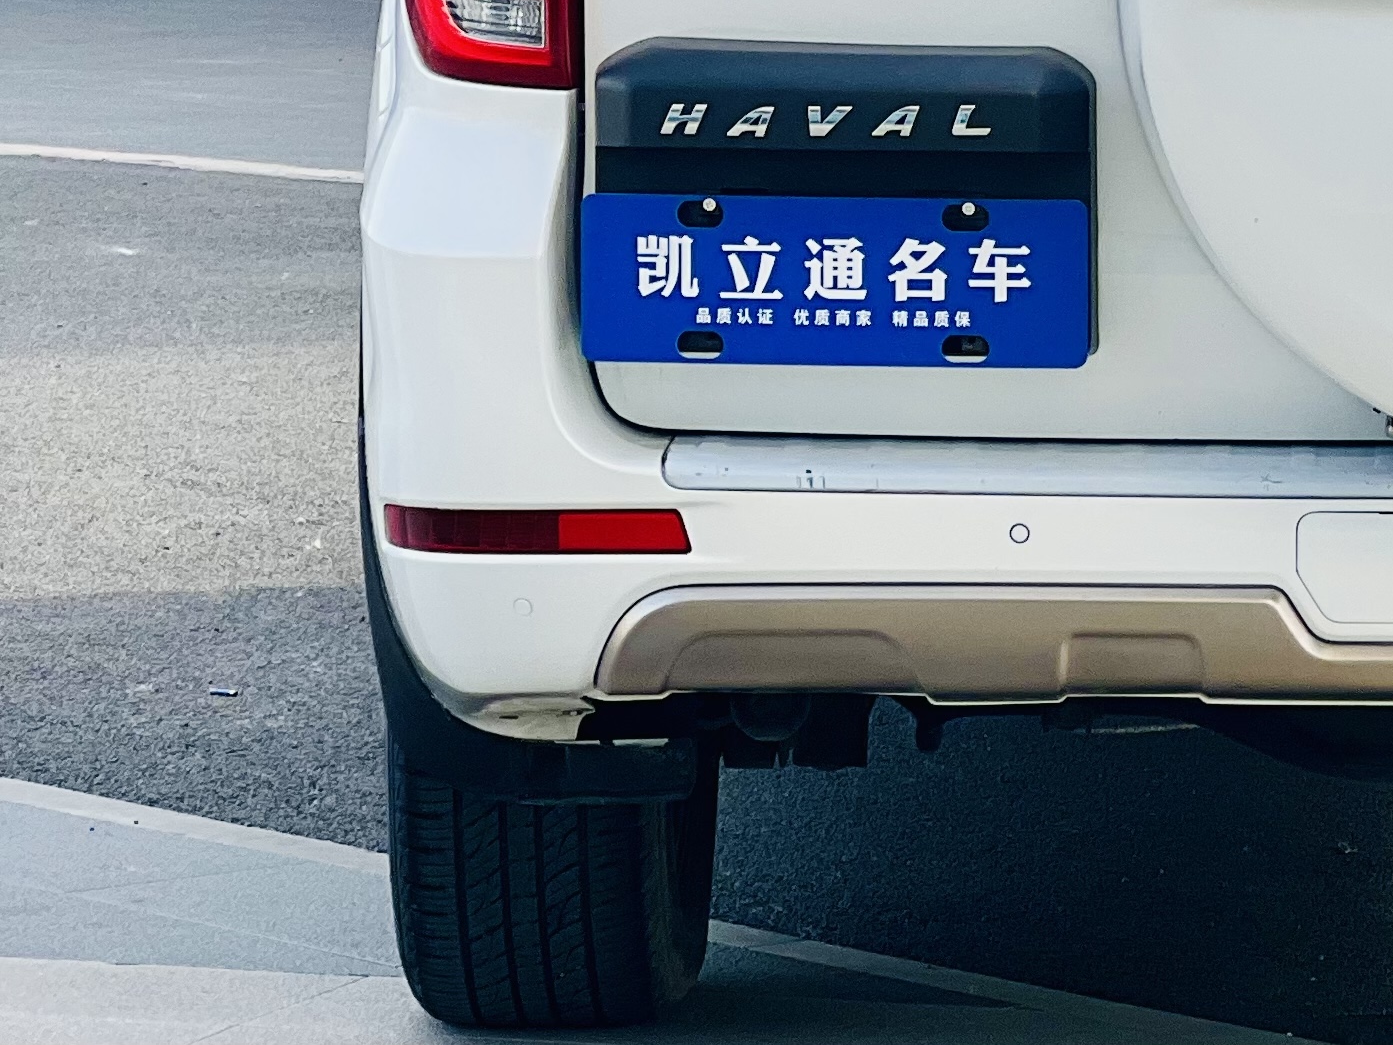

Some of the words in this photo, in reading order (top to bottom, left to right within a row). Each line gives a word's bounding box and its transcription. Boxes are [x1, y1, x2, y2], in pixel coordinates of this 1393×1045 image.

[659, 103, 992, 138] HAVAL
[636, 234, 1032, 304] 凯立通名车
[695, 307, 775, 326] 品质认证
[793, 308, 873, 327] 优质商家
[892, 309, 972, 328] 精品质保
